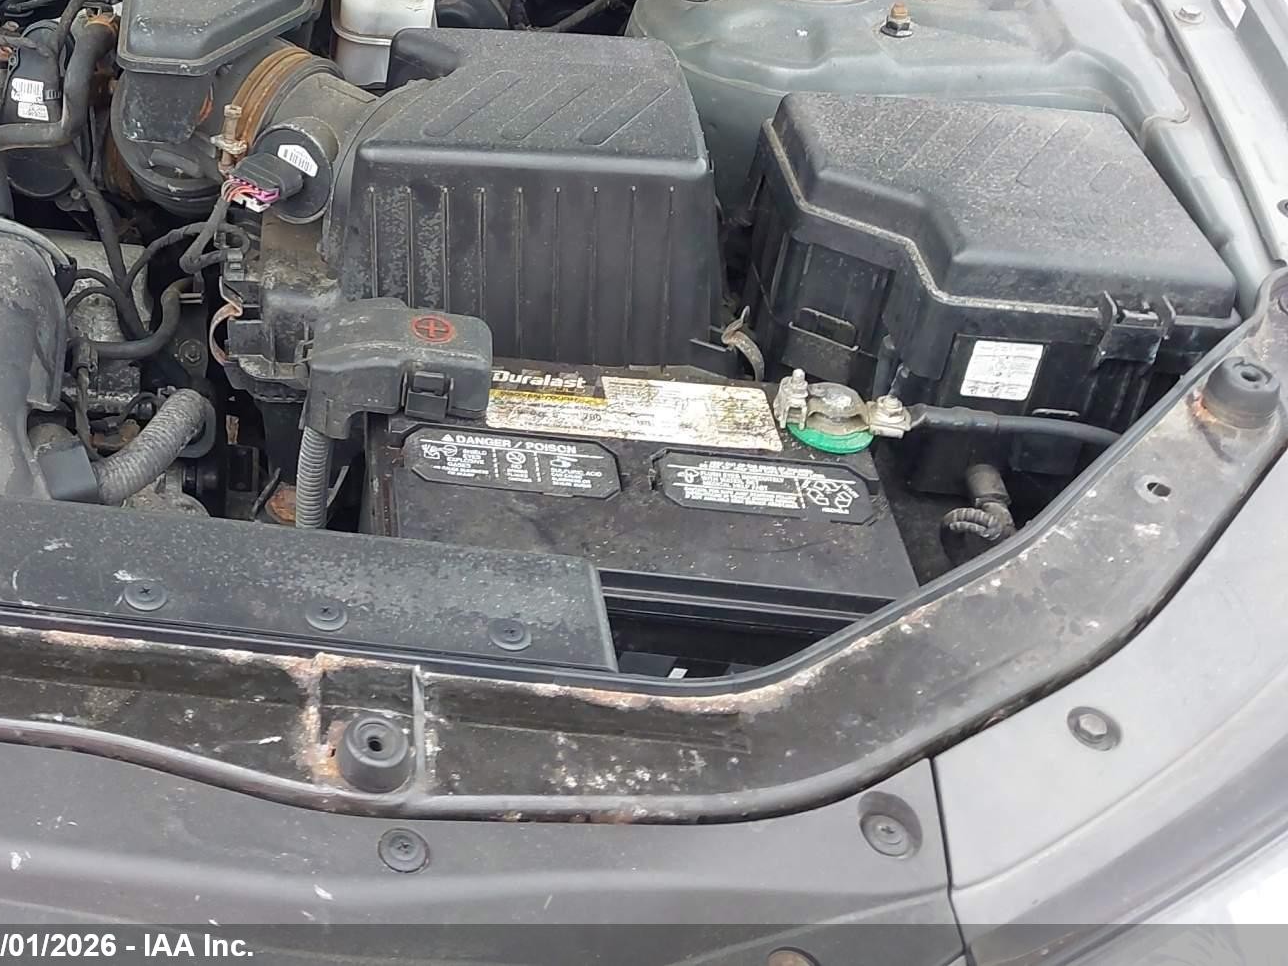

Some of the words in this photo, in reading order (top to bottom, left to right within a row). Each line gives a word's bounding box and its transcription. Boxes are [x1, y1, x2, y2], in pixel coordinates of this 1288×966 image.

[491, 370, 587, 389] Duralast
[455, 435, 512, 448] DANGER
[525, 441, 577, 454] POISON
[446, 456, 485, 465] EXPLOSIVE
[550, 467, 584, 475] SULFURIC
